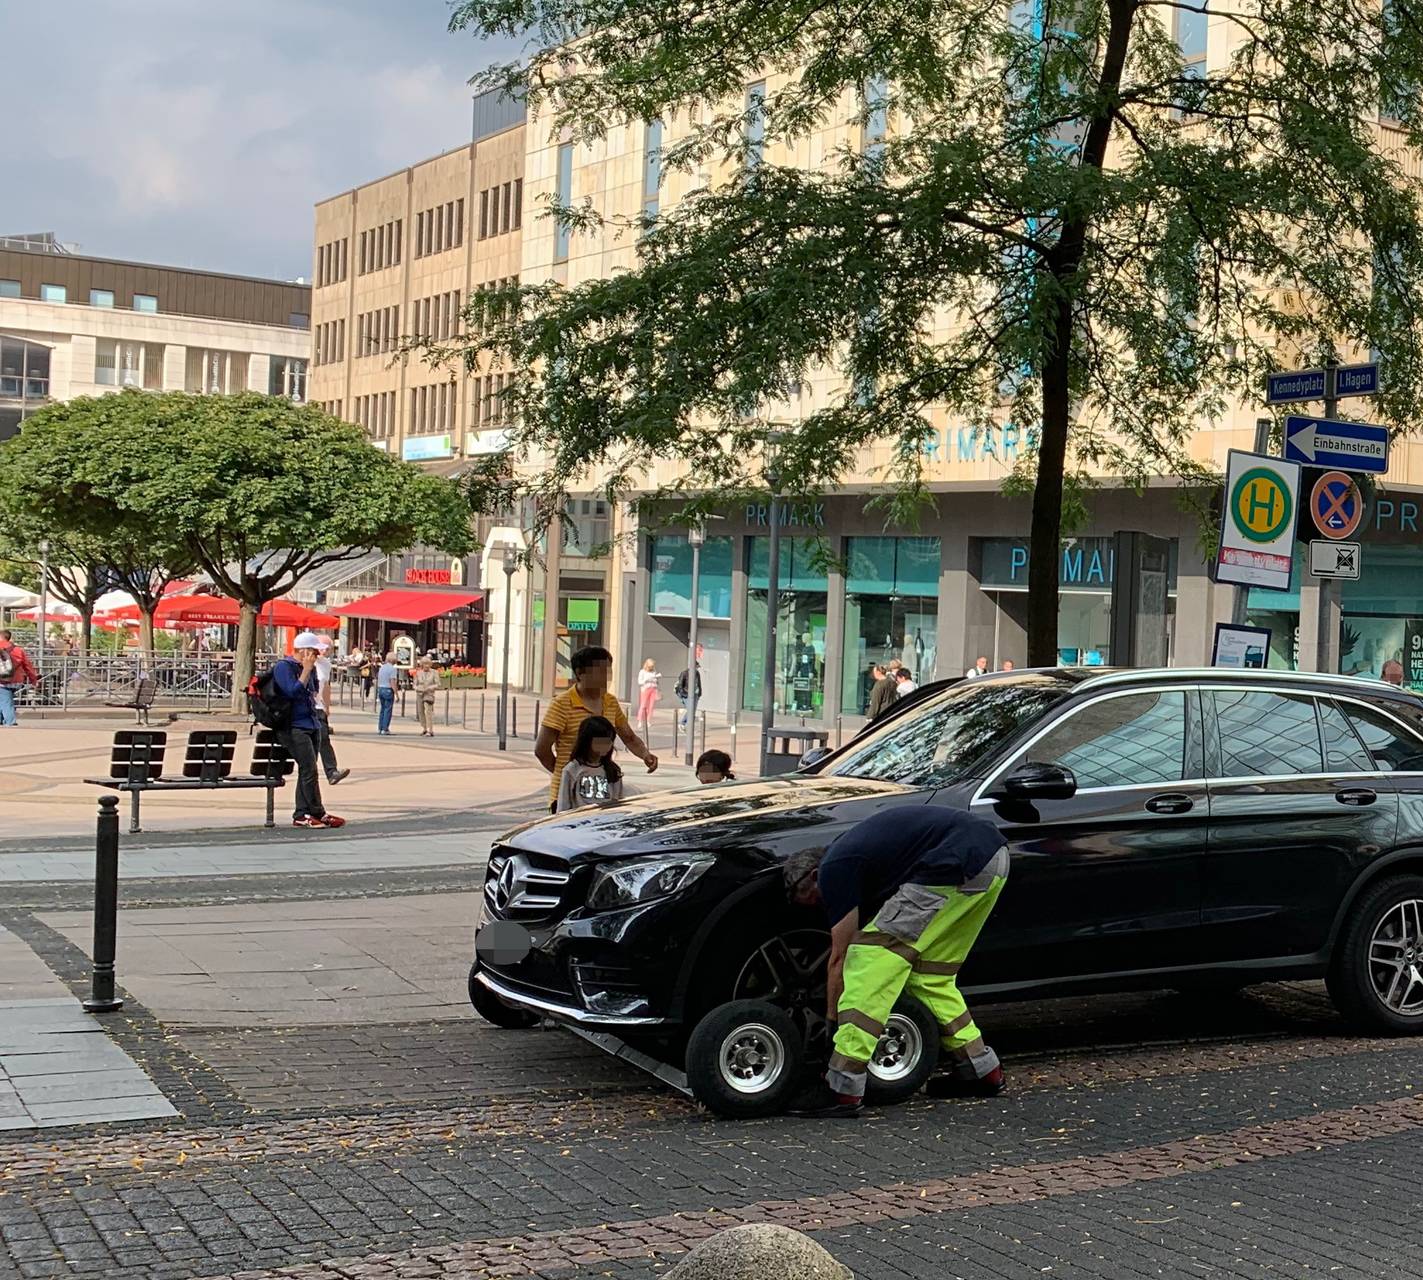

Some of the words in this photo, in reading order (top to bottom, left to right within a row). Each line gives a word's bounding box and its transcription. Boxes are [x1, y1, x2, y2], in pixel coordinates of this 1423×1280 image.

[1273, 376, 1324, 395] Kennedyplatz
[1314, 437, 1381, 455] Einbahnstraße
[1249, 483, 1276, 527] H
[746, 504, 824, 526] PRMARK
[567, 623, 599, 631] DATEV
